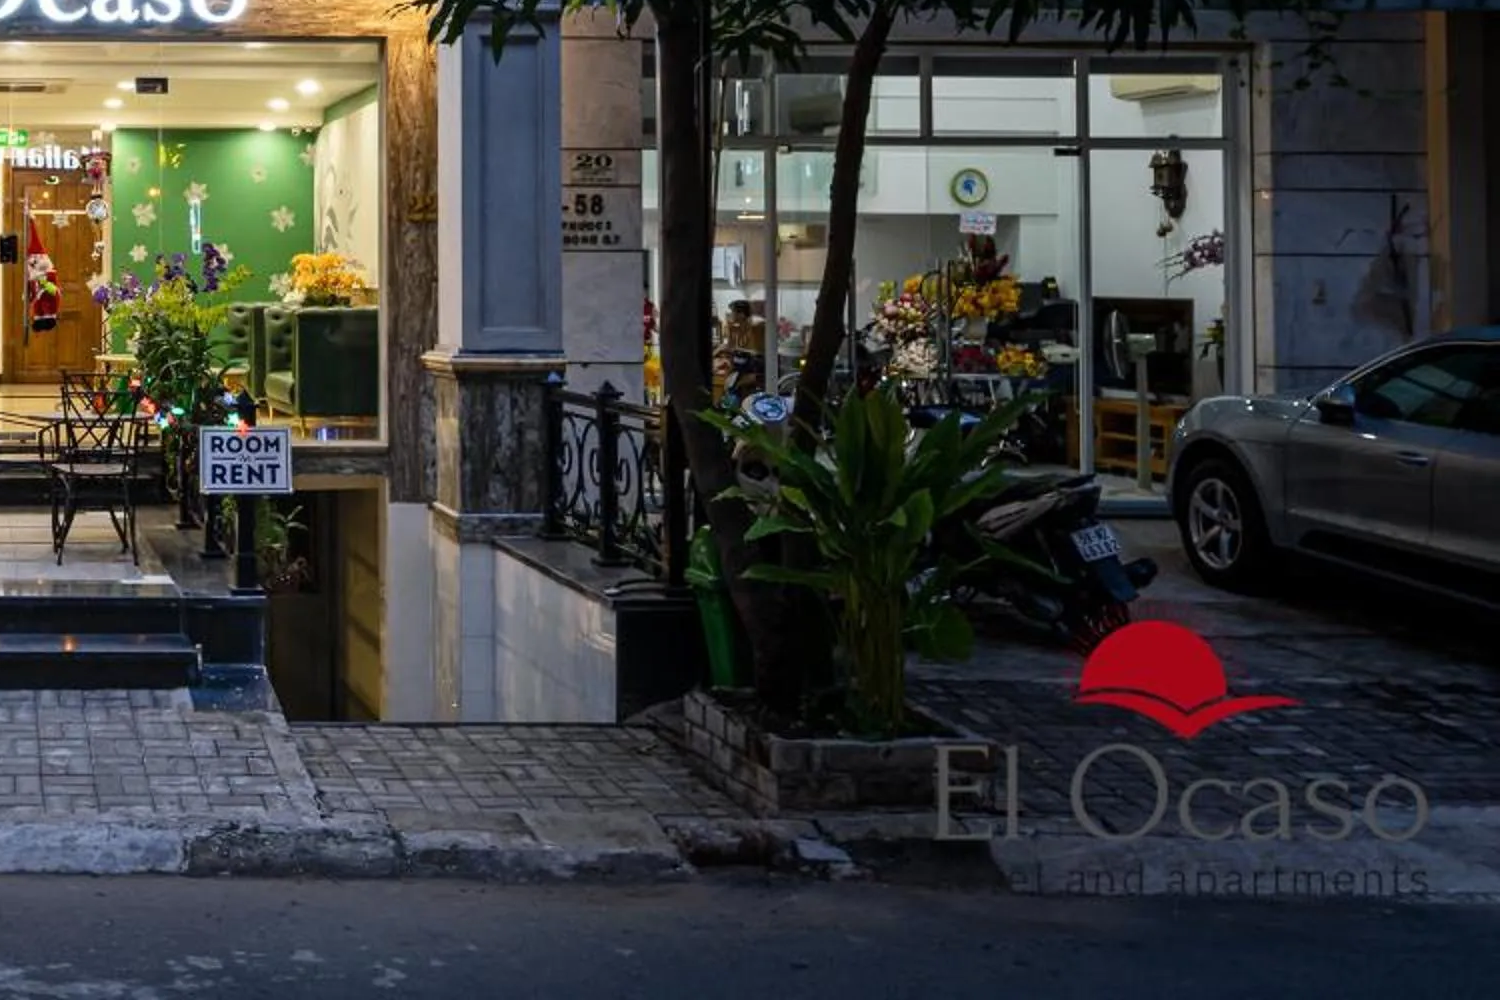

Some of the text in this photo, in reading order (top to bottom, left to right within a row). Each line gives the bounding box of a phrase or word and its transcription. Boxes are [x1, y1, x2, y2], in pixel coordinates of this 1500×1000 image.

[576, 153, 613, 168] 20
[575, 193, 603, 216] 58
[211, 435, 280, 453] ROOM
[211, 463, 280, 485] RENT
